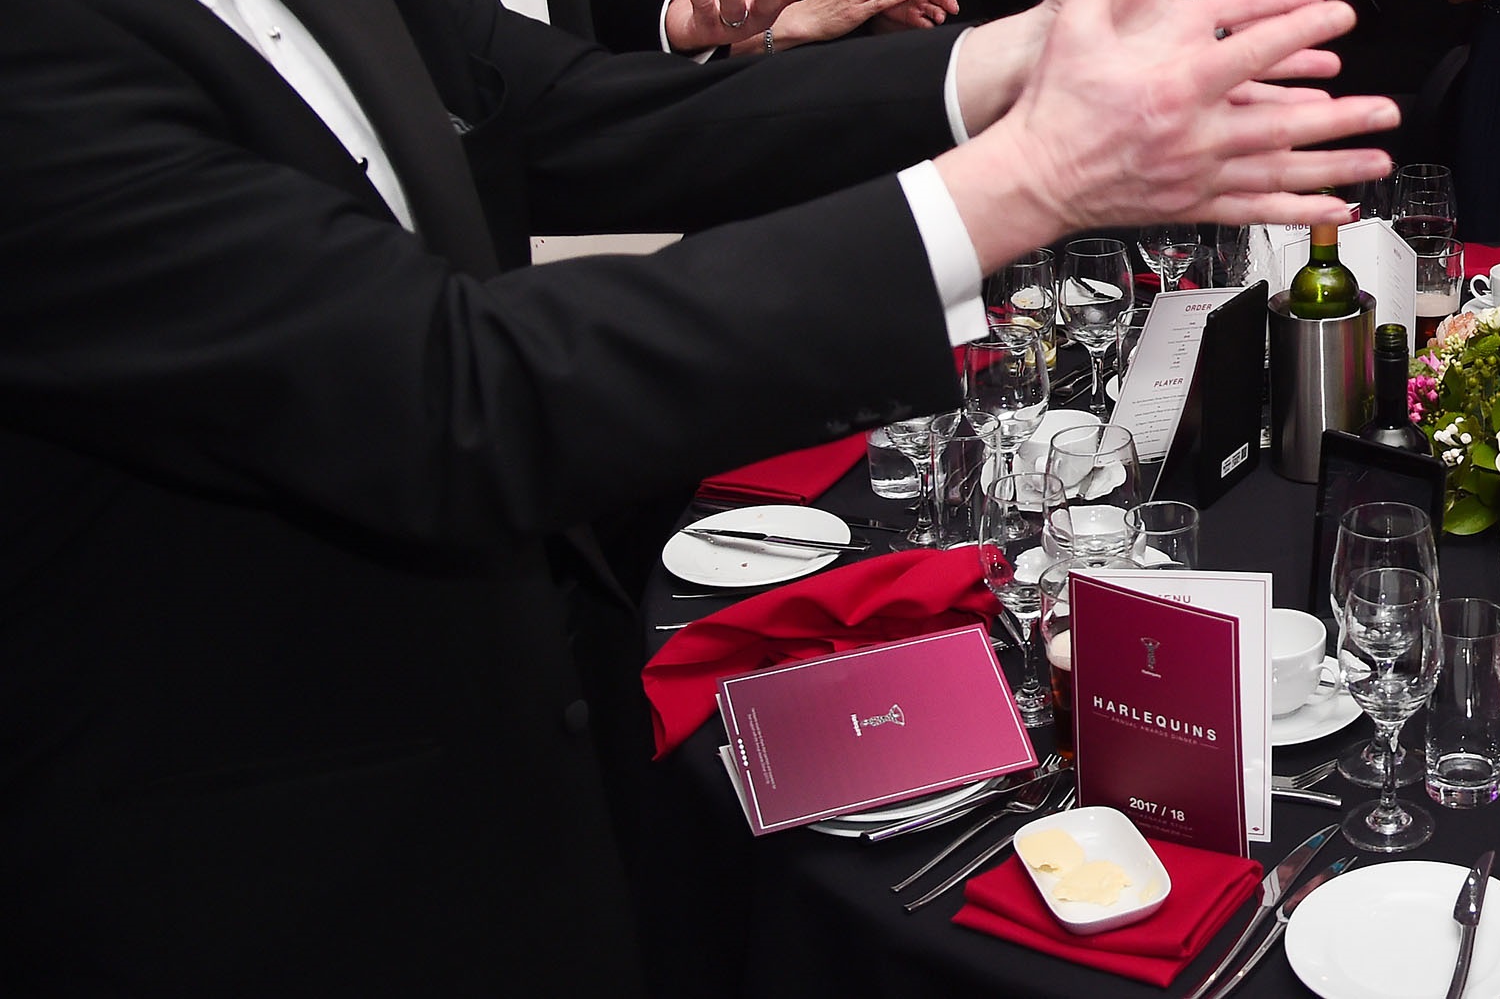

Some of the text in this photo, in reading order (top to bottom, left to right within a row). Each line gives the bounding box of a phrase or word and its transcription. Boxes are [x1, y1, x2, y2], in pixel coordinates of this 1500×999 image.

[1285, 224, 1310, 232] ORDE
[1185, 303, 1213, 312] ORDER
[1154, 377, 1184, 388] PLAYER
[1093, 695, 1217, 741] HARLEQUINS
[1170, 733, 1198, 745] DINNER
[1129, 797, 1158, 814] 2017
[1170, 809, 1185, 822] 18
